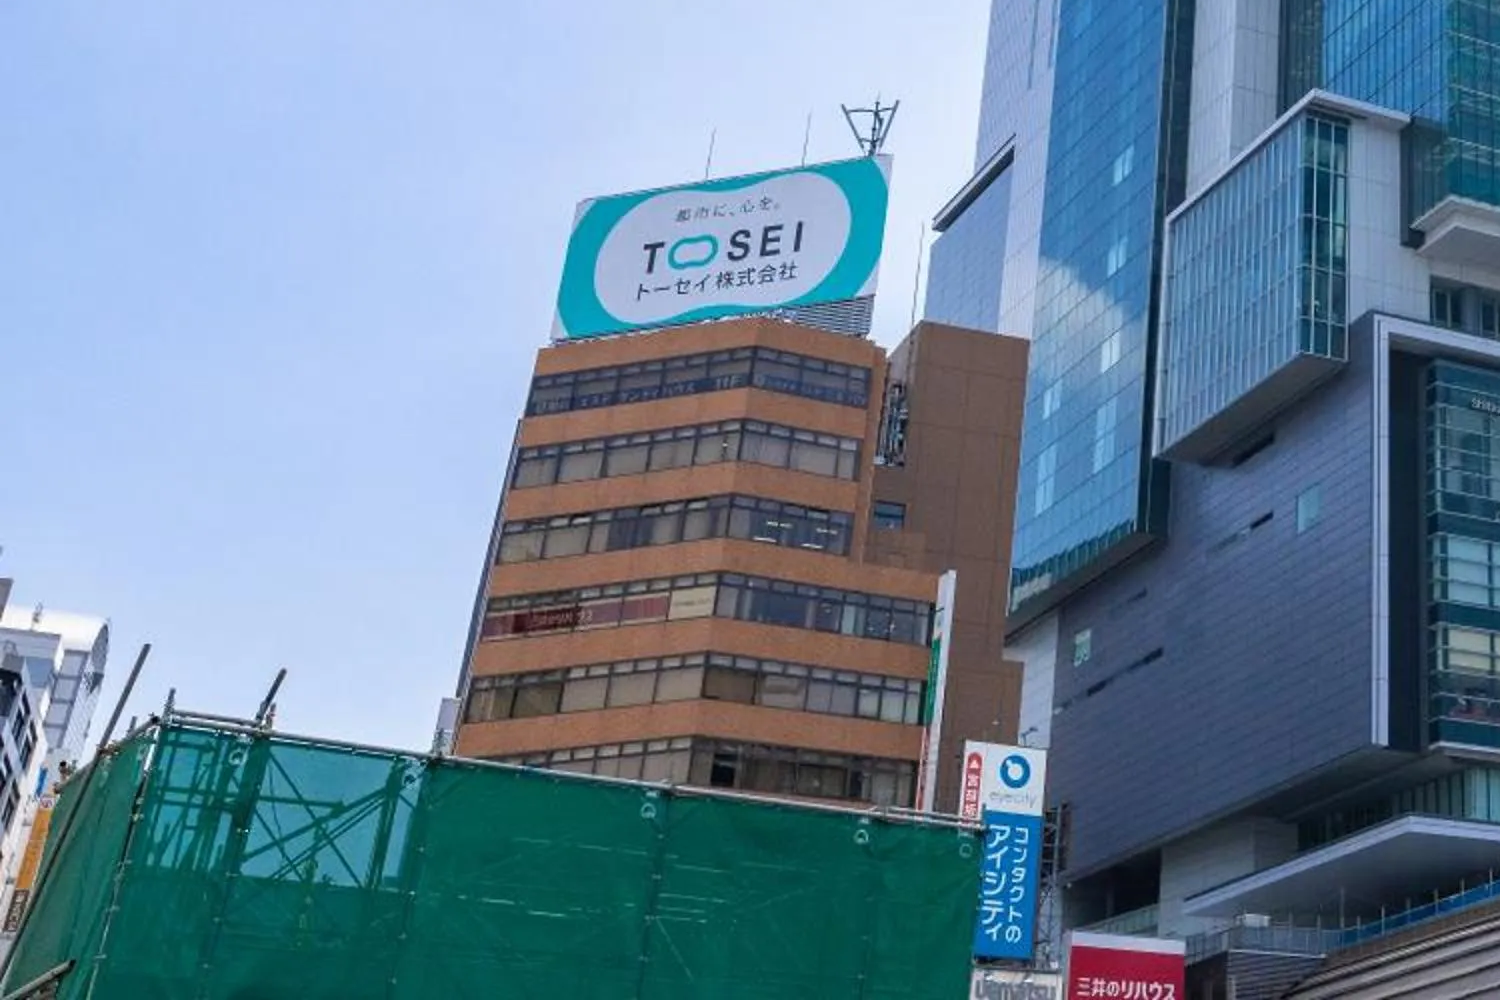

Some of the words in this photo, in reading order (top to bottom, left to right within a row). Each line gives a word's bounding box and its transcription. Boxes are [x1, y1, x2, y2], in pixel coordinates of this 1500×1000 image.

[643, 221, 804, 275] TOSEI
[636, 260, 799, 301] トーセイ株式会社
[981, 823, 1011, 942] アイシティ
[1005, 826, 1029, 943] コンタクトの
[1076, 977, 1176, 1000] 三井のリハウス
